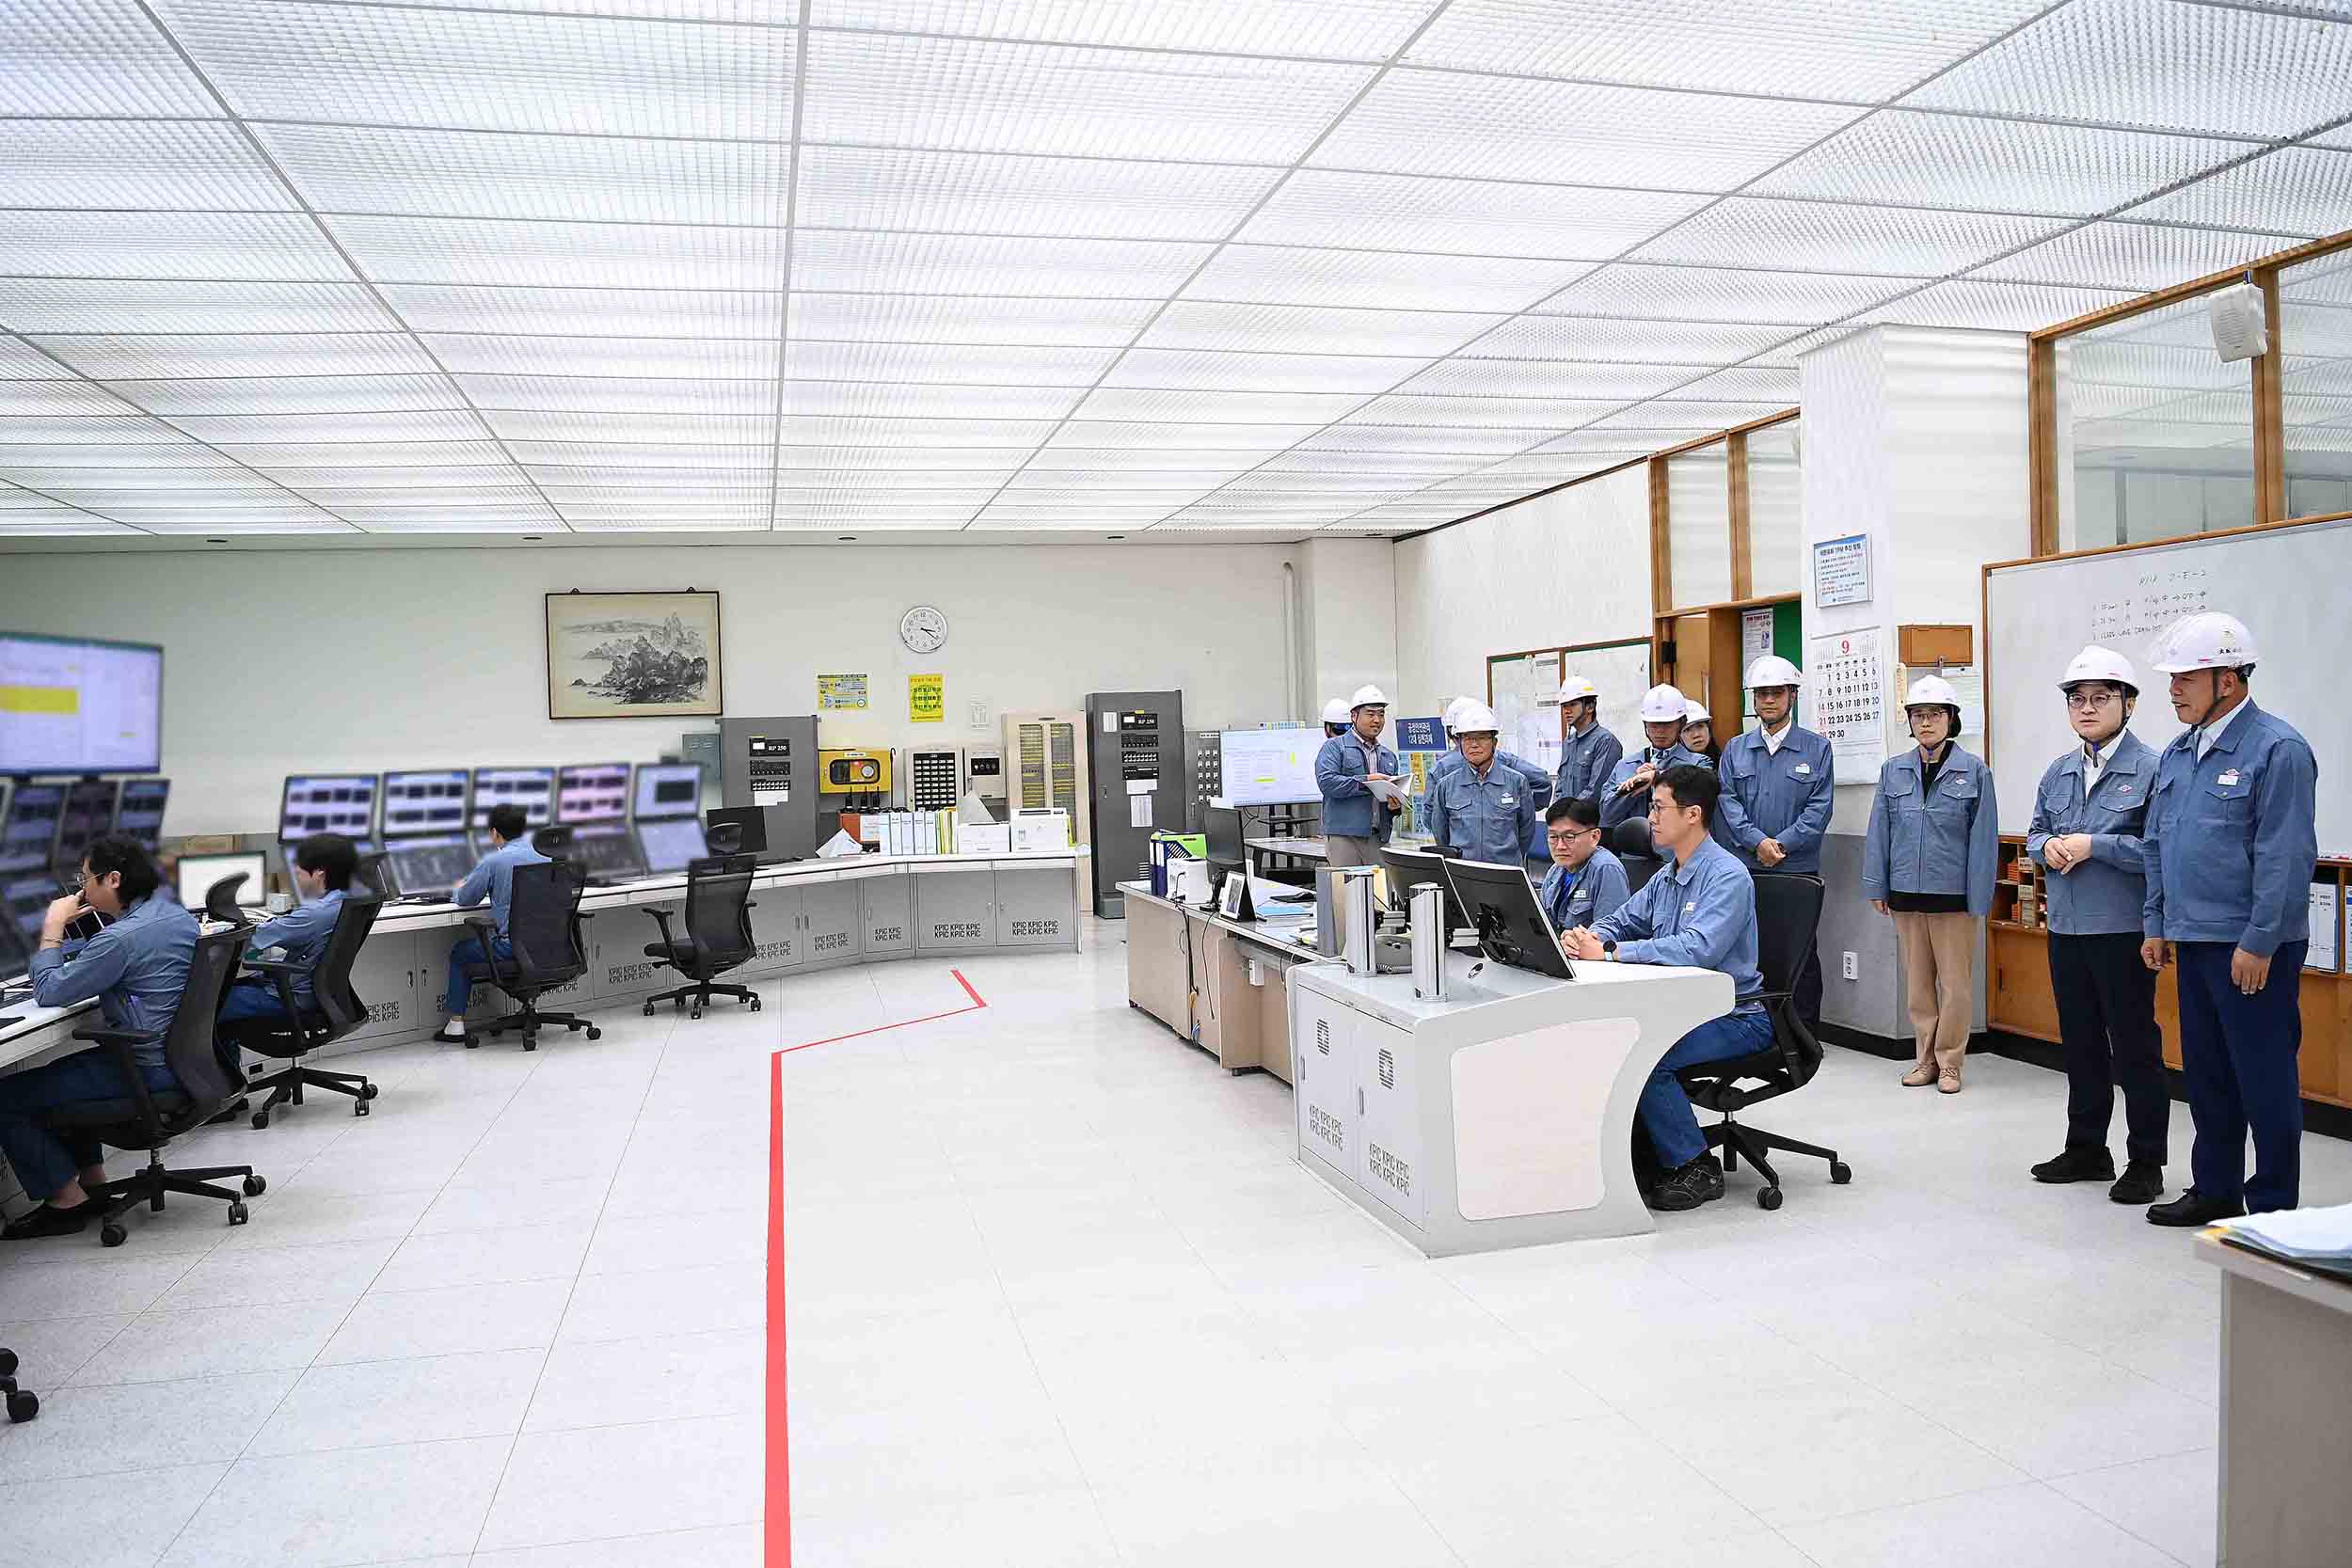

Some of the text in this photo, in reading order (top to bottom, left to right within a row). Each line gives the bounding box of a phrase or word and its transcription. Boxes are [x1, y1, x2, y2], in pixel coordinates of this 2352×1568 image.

[1842, 640, 1849, 654] 9
[1872, 711, 1879, 720] 27
[367, 1001, 399, 1013] PIC KPIC
[367, 1011, 399, 1023] PIC KPIC
[1309, 1104, 1343, 1136] KPIC KPIC KPIC
[1309, 1119, 1343, 1152] KPIC KPIC KPIC
[1369, 1142, 1409, 1180] KPIC KPIC KPIC
[1370, 1158, 1410, 1197] KPIC KPIC KPIC
